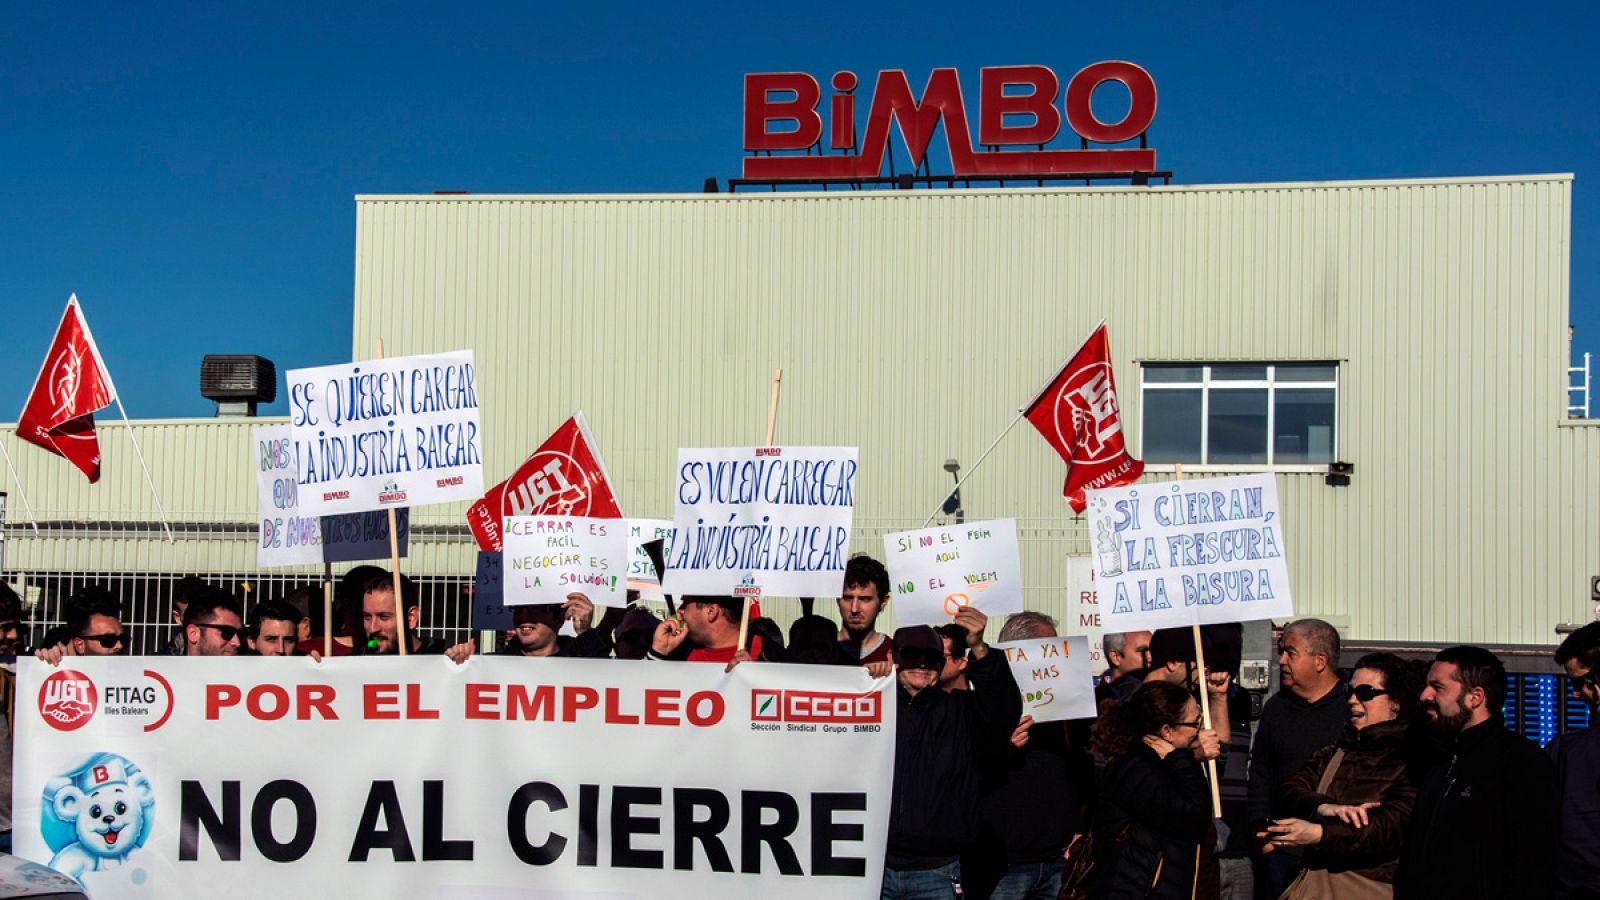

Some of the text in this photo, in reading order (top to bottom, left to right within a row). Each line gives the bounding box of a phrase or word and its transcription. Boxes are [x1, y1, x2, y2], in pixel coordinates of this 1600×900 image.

[291, 382, 319, 427] SE
[411, 363, 478, 414] CARGAR
[259, 438, 290, 472] NOS
[295, 440, 318, 485] LA
[415, 421, 481, 472] BALEAR
[508, 457, 569, 517] UGT
[680, 459, 857, 507] ES VOLEN CARREGAR
[263, 518, 283, 549] DE
[590, 525, 607, 537] ES
[919, 535, 933, 548] NO
[941, 532, 954, 545] EL
[666, 527, 690, 570] LA
[774, 526, 847, 571] BALEAR
[1124, 526, 1281, 572] LA FRESCURA
[590, 558, 609, 571] ES
[524, 576, 542, 588] LA
[898, 571, 998, 594] NO EL VOLEM
[1112, 568, 1275, 614] A LA BASURA
[1032, 664, 1060, 680] MAS
[44, 680, 91, 704] UGT
[104, 686, 156, 704] FITAG
[104, 706, 149, 716] Illes Balears
[205, 683, 726, 727] POR EL EMPLEO
[789, 694, 878, 716] CCOO
[751, 722, 881, 735] Sección Sindical Grupo BIMBO
[92, 764, 110, 785] B
[178, 779, 867, 878] NO AL CIERRE
